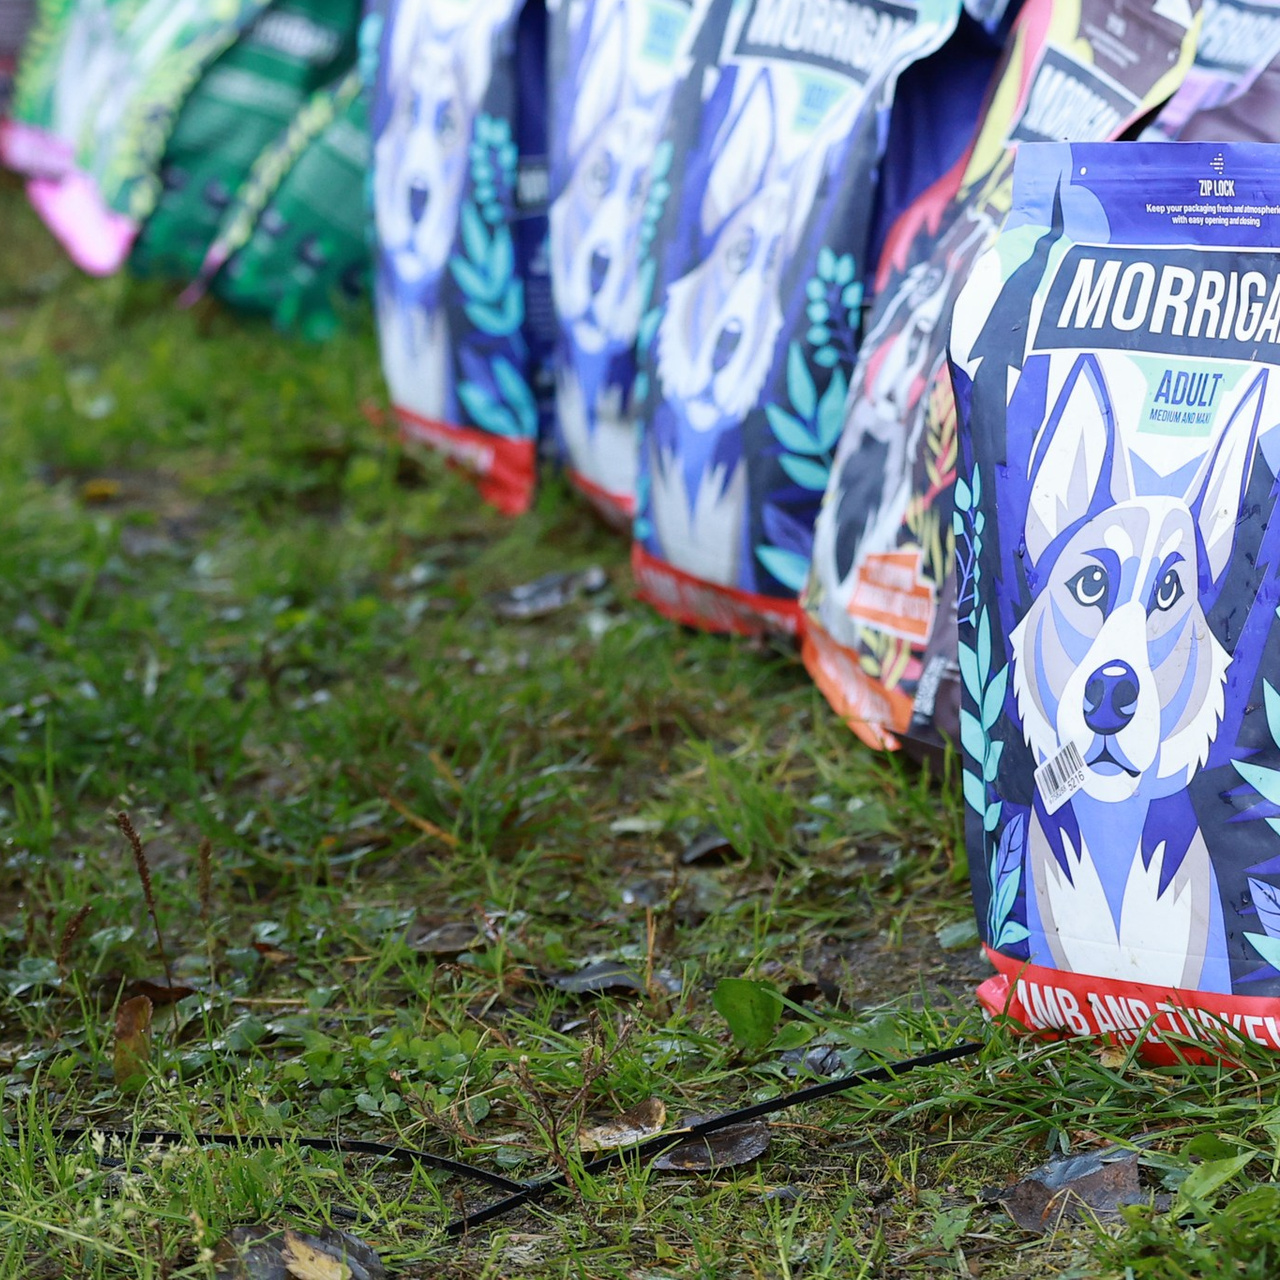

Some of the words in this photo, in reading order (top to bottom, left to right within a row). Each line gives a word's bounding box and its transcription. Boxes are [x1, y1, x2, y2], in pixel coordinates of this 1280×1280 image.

[1199, 179, 1213, 197] ZIP
[1214, 180, 1236, 197] LOCK
[1146, 203, 1166, 215] Keep
[1166, 205, 1183, 215] your
[1183, 203, 1217, 215] packaging
[1217, 204, 1233, 213] fresh
[1233, 205, 1244, 214] and
[1172, 215, 1188, 225] with
[1188, 217, 1204, 226] easy
[1205, 216, 1229, 227] opening
[1229, 217, 1240, 225] and
[1154, 369, 1223, 407] ADULT
[1149, 408, 1182, 423] MEDIUM
[1181, 412, 1196, 424] AND
[1067, 770, 1085, 792] 5216
[1087, 992, 1165, 1044] AND
